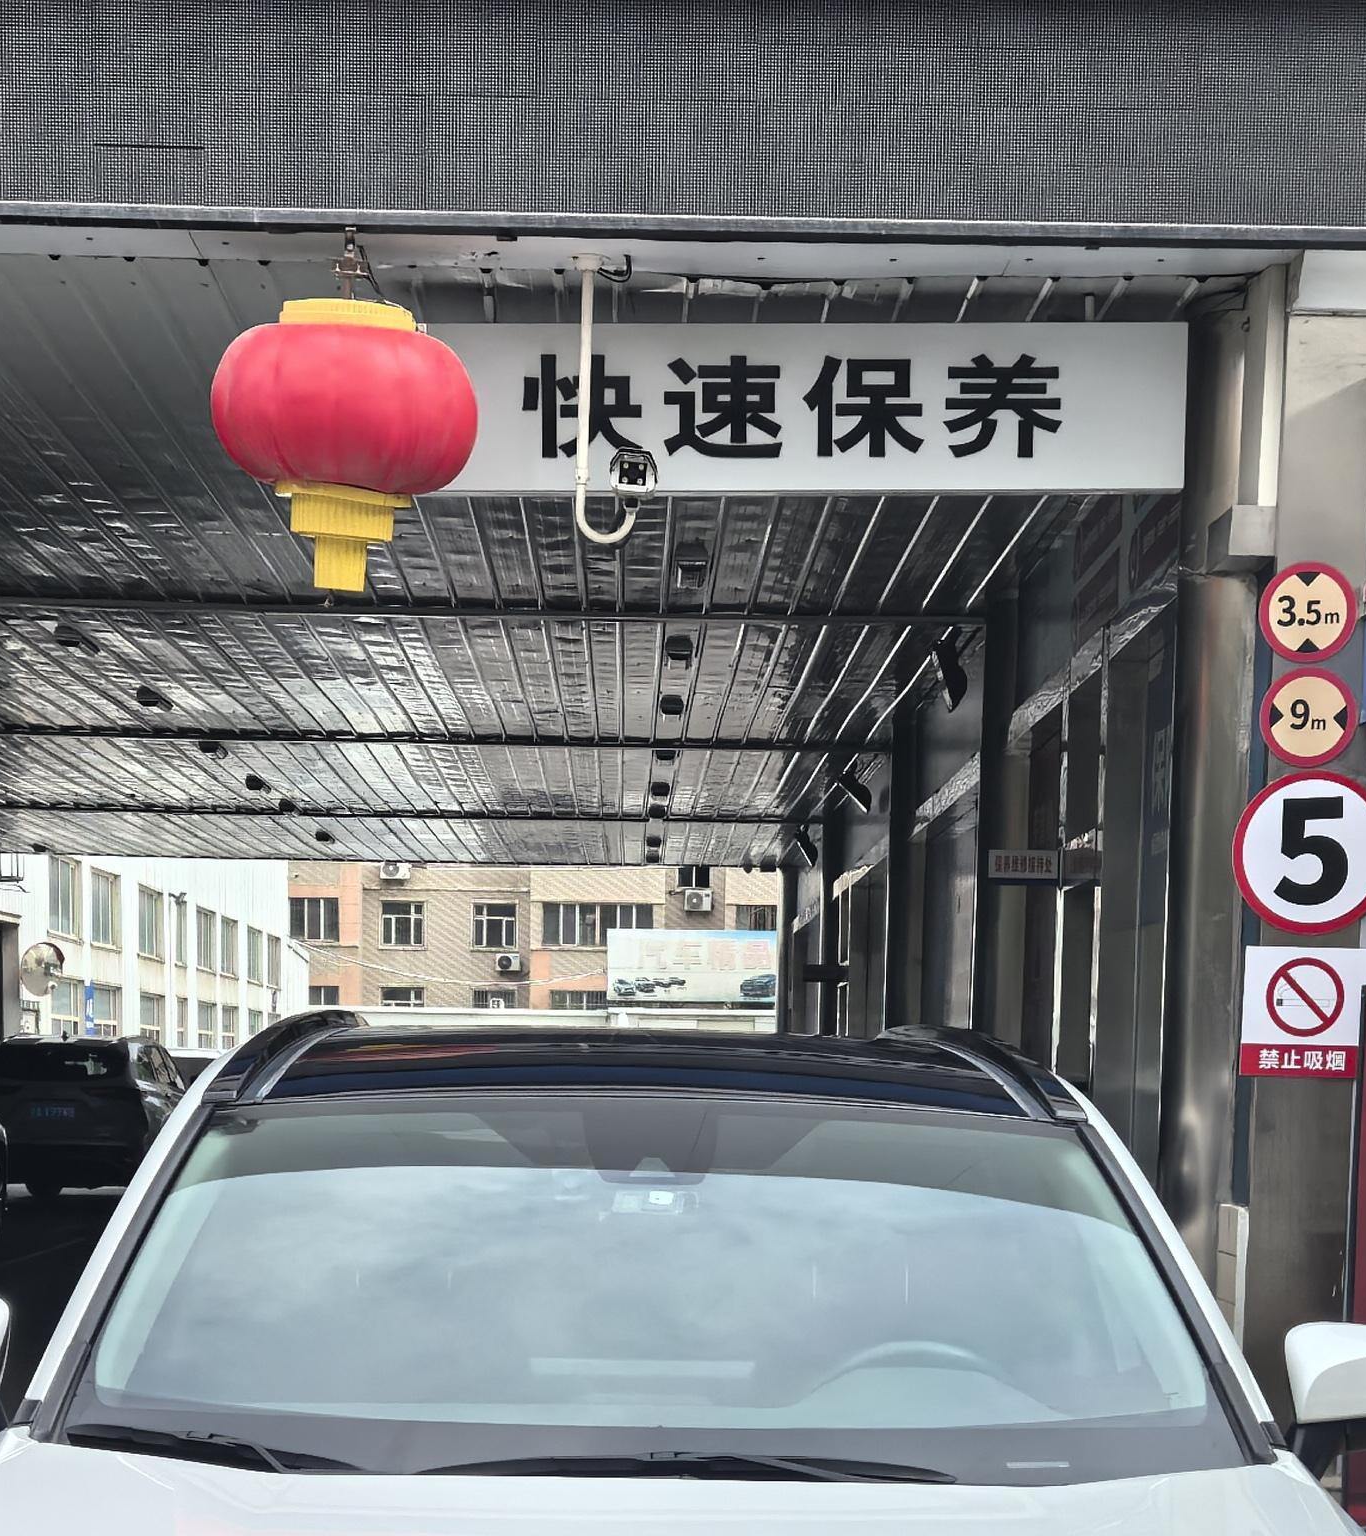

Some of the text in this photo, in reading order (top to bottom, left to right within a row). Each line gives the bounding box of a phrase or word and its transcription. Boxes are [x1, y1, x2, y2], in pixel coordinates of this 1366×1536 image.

[521, 353, 1063, 460] 快速保养
[1276, 595, 1340, 627] 3.5m
[1289, 698, 1326, 731] 9m
[1273, 796, 1349, 906] 5
[1258, 1048, 1346, 1072] 禁止吸烟
